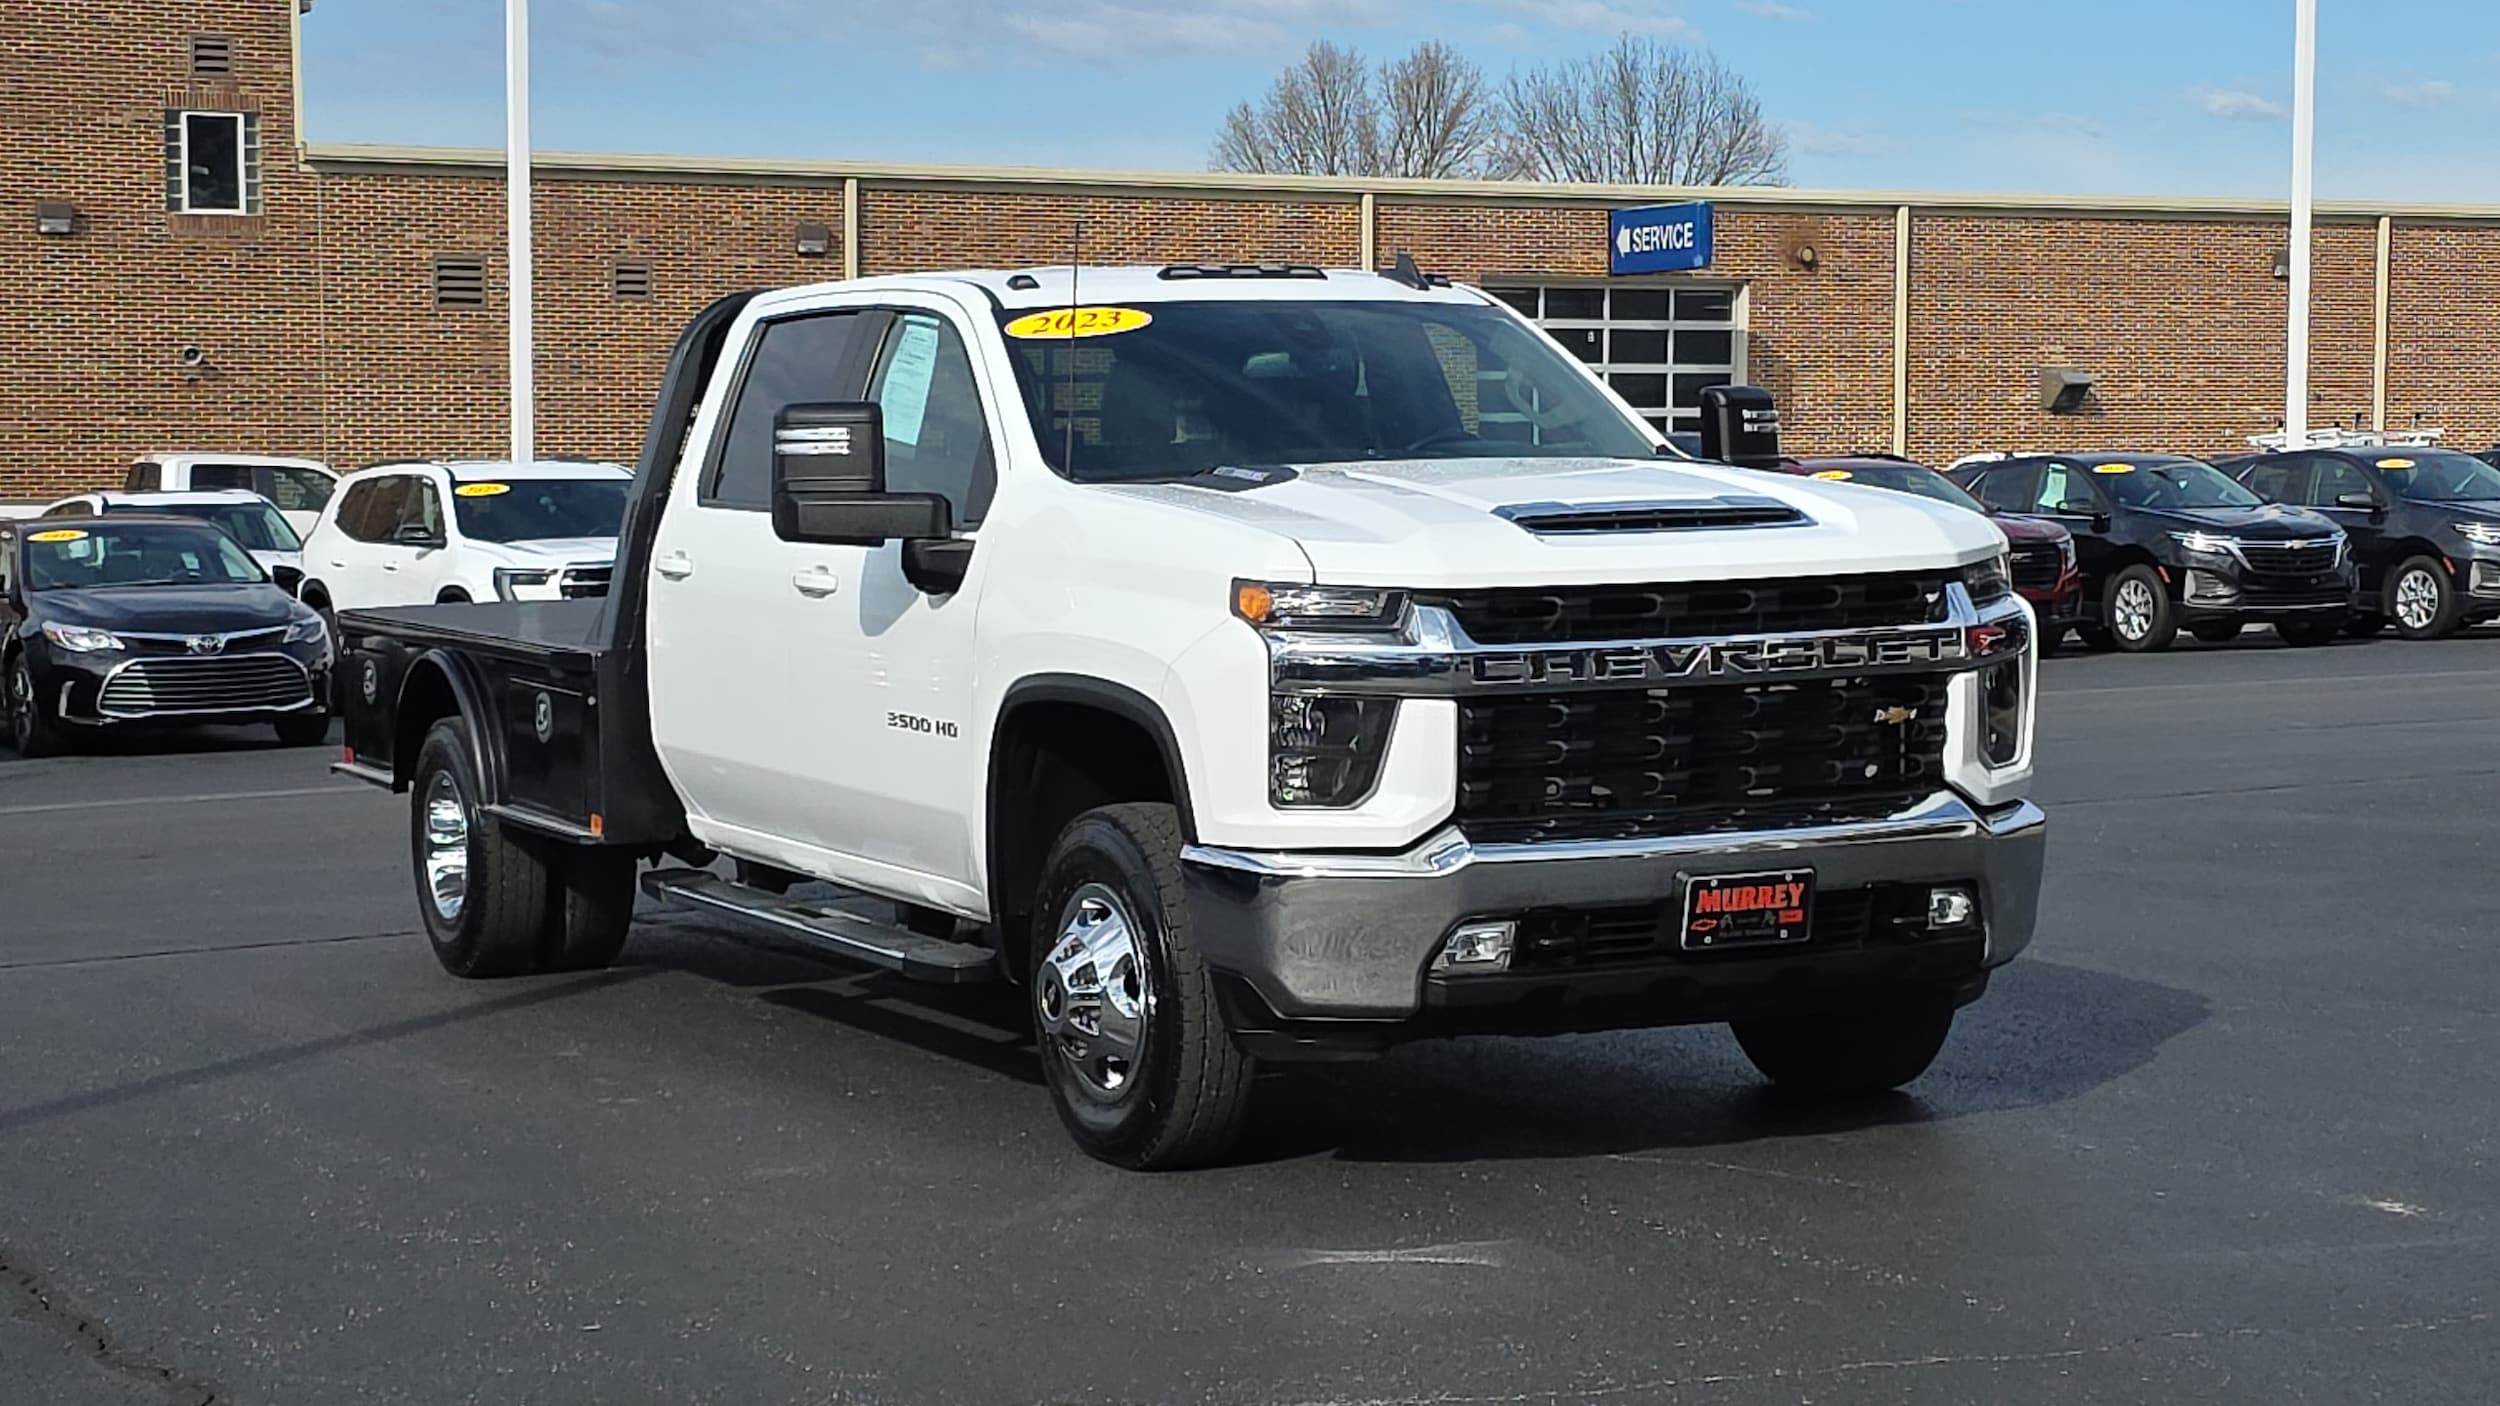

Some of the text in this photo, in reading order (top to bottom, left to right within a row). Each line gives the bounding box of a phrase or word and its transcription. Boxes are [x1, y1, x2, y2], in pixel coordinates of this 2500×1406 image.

[1632, 222, 1694, 252] SERVICE
[1031, 311, 1122, 334] 2023
[1471, 629, 1957, 684] CHEVROLET
[887, 712, 958, 738] 3500 HD
[1695, 882, 1805, 913] MURREY
